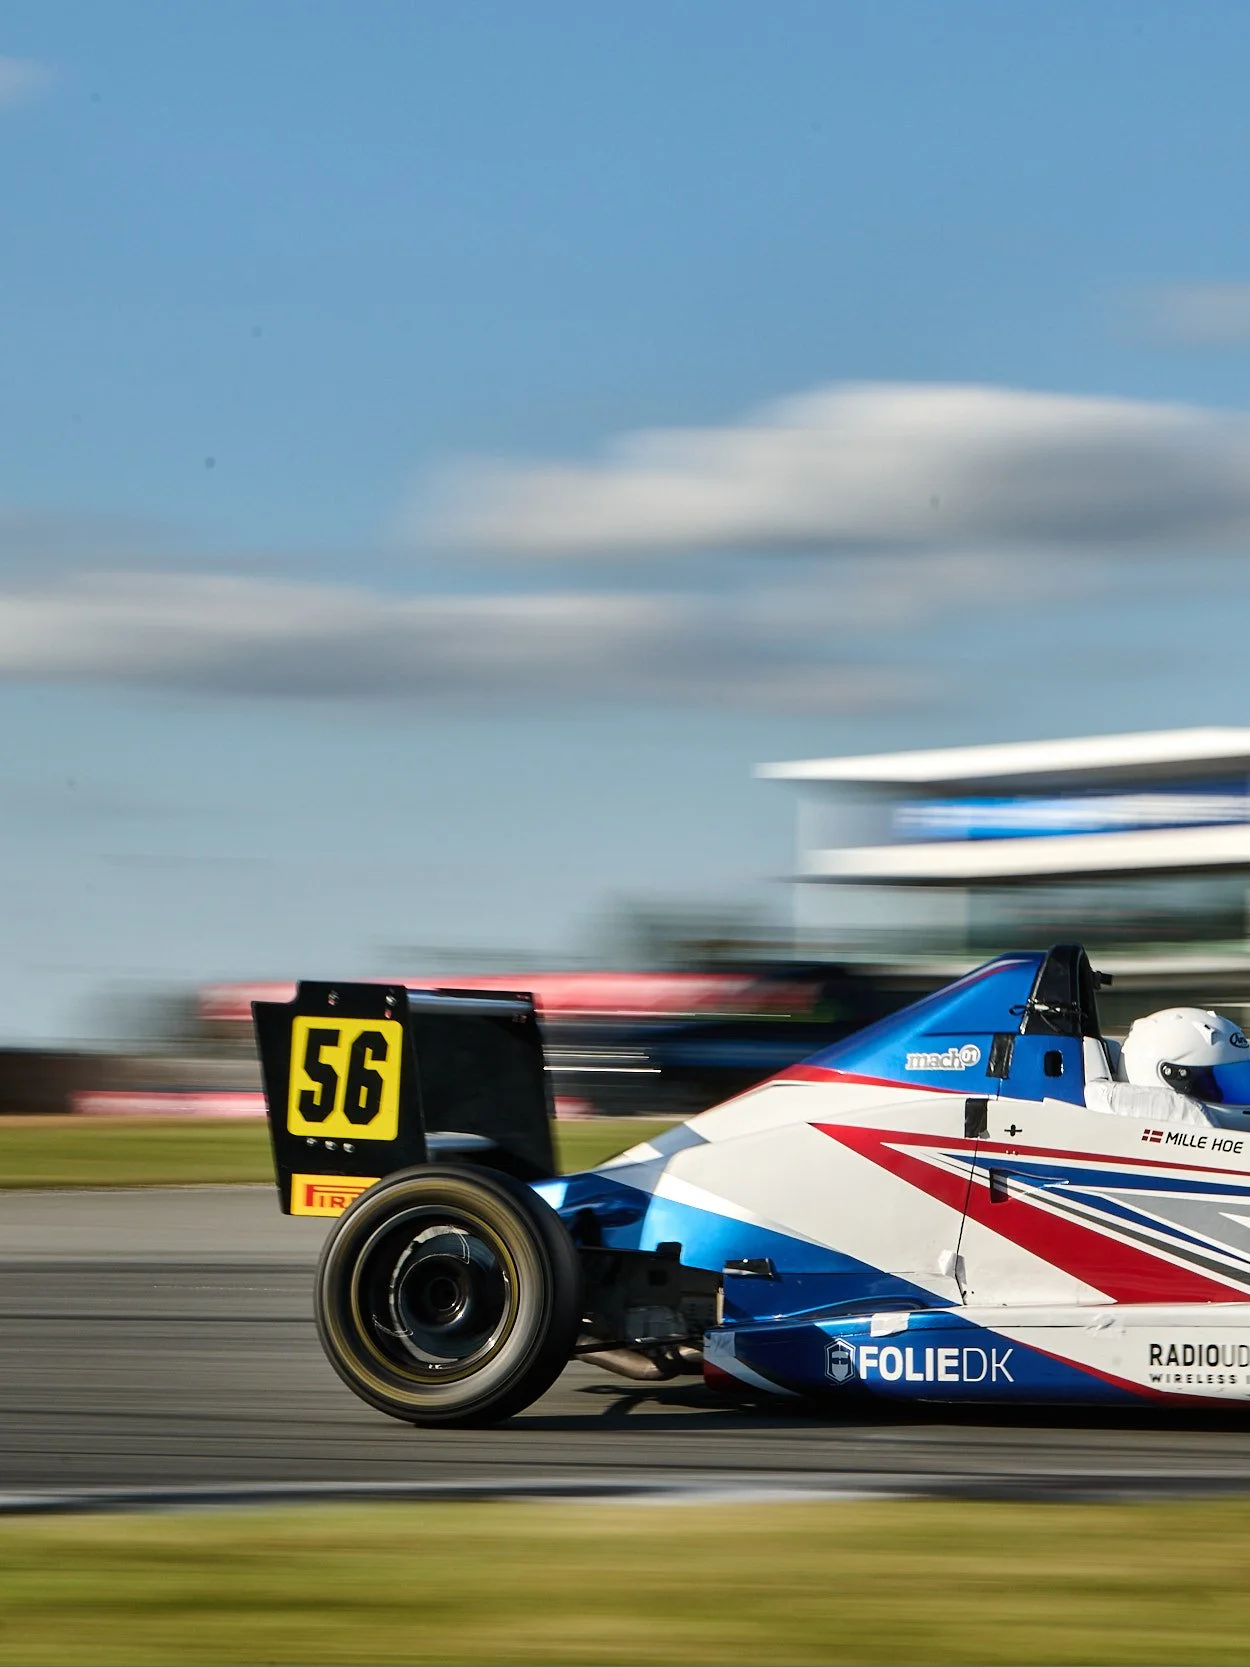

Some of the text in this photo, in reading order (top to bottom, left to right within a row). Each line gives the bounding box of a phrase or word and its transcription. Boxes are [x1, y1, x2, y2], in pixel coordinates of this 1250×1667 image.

[299, 1028, 388, 1125] 56
[1165, 1131, 1244, 1154] MILLE HOE
[859, 1345, 1014, 1382] FOLIEDK
[1149, 1373, 1238, 1384] WIRELESS
